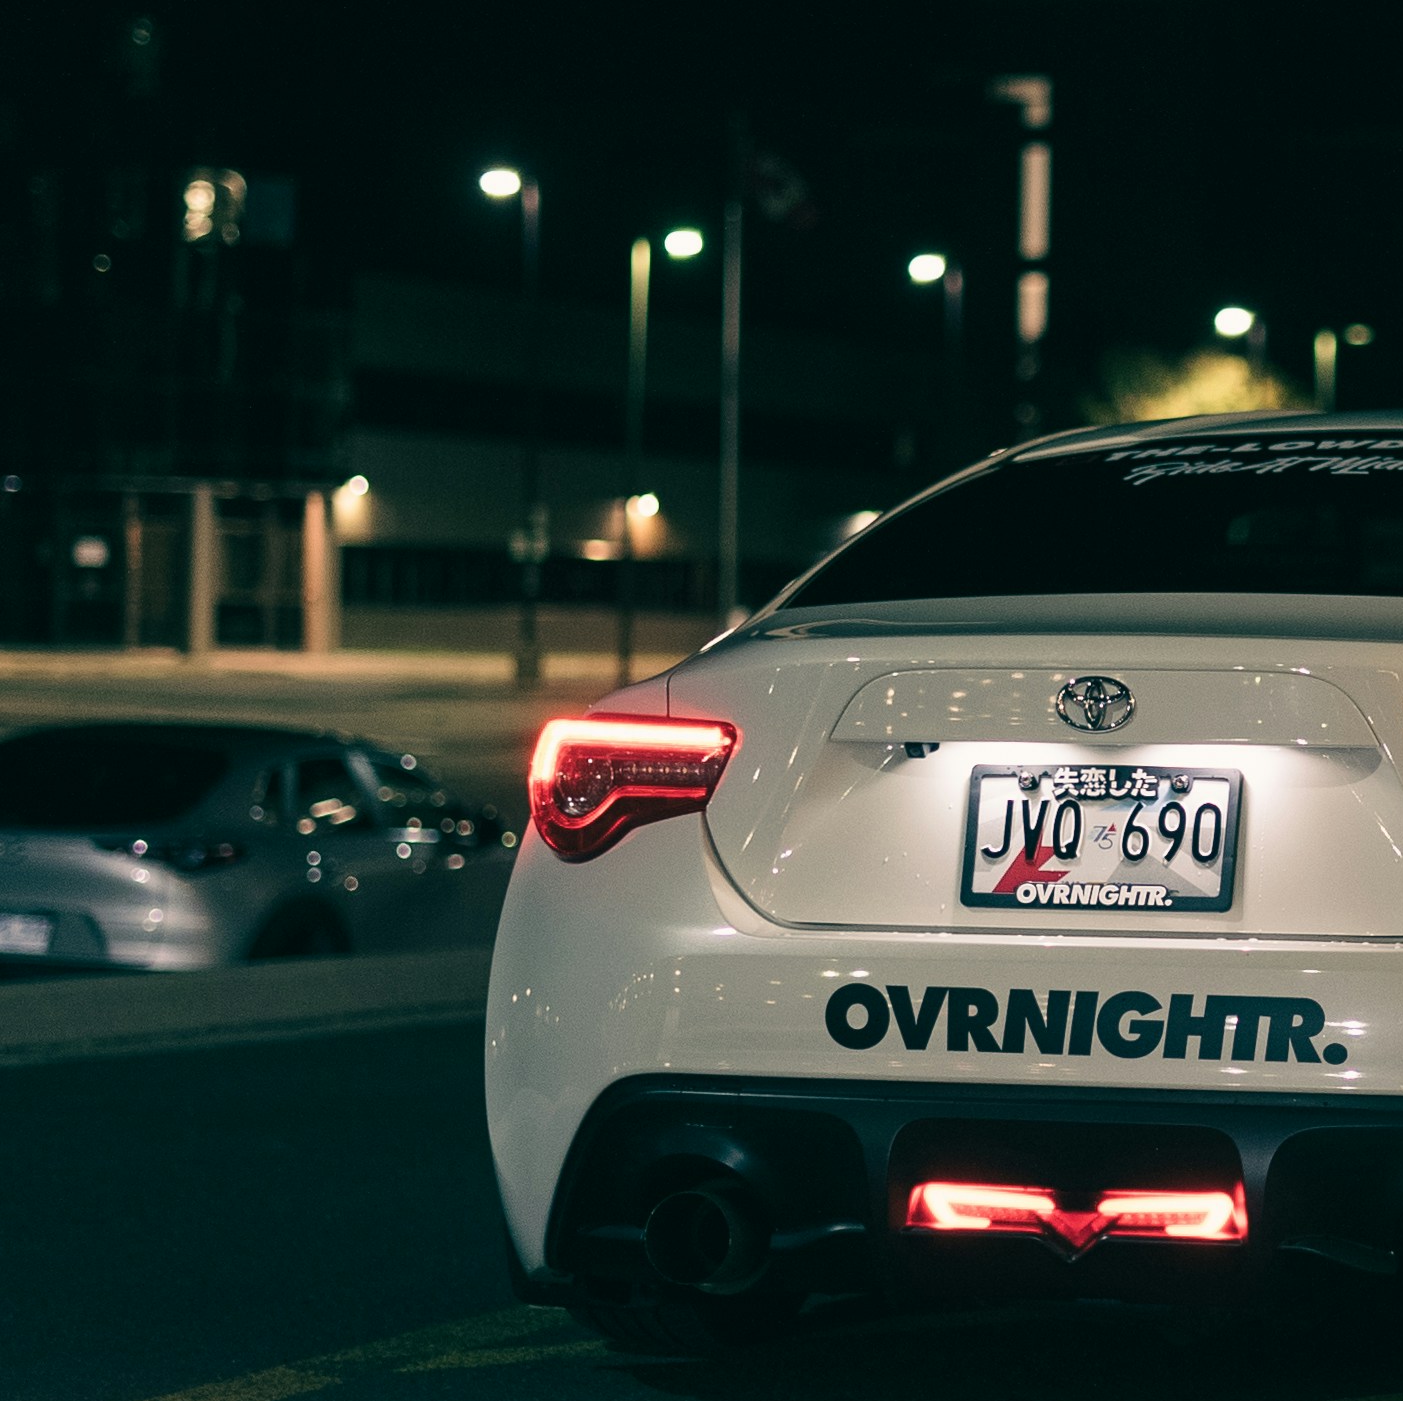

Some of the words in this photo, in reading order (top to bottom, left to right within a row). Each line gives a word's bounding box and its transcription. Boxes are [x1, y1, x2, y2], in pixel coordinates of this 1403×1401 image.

[1053, 767, 1158, 798] 失恋した
[981, 799, 1082, 861] JVQ
[1122, 801, 1222, 863] 690
[1093, 825, 1117, 850] 75
[1016, 882, 1173, 907] OVRNIGHTR.
[825, 982, 1348, 1065] OVRNIGHTR.
